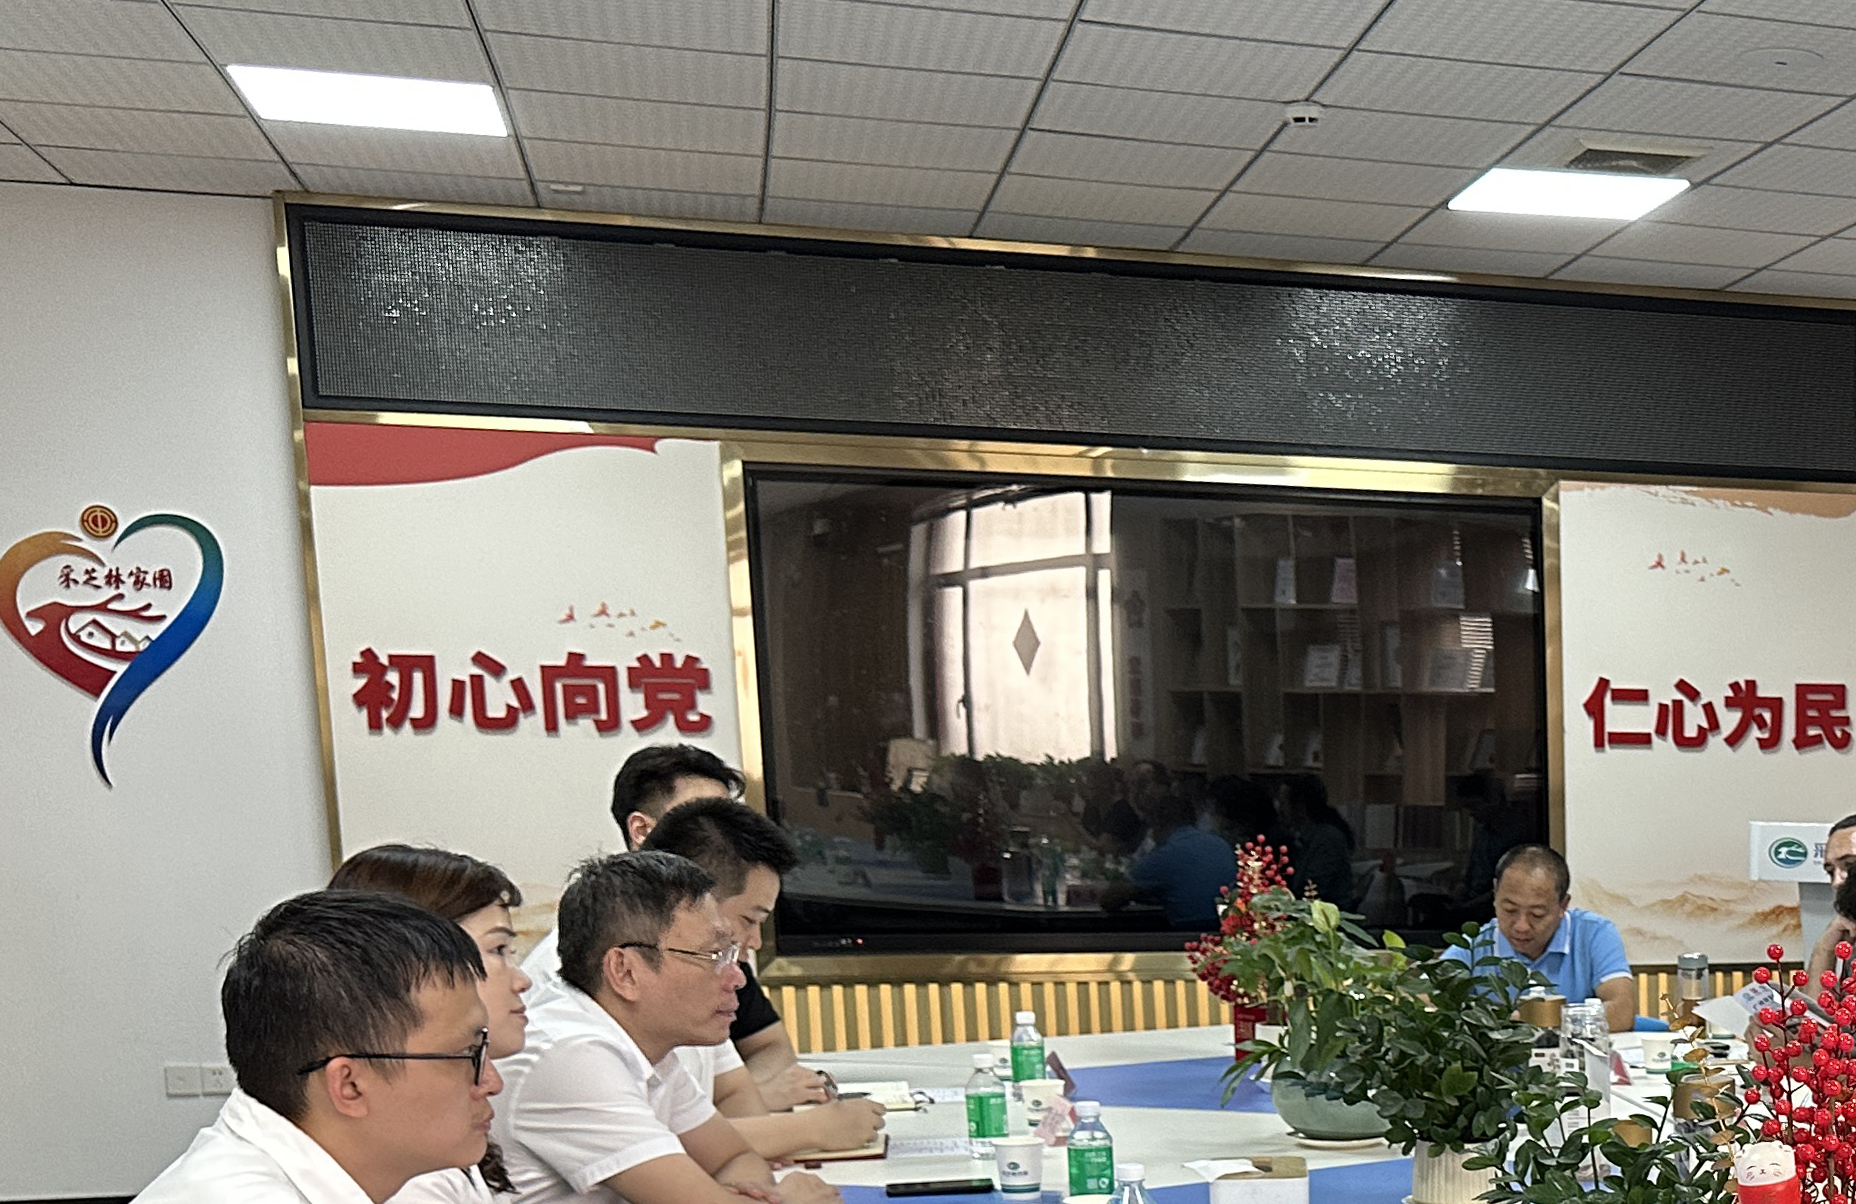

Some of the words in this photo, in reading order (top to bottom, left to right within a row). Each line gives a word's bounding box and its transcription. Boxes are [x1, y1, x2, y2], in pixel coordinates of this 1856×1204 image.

[352, 648, 713, 735] 初心向党
[1583, 676, 1854, 752] 仁心为民
